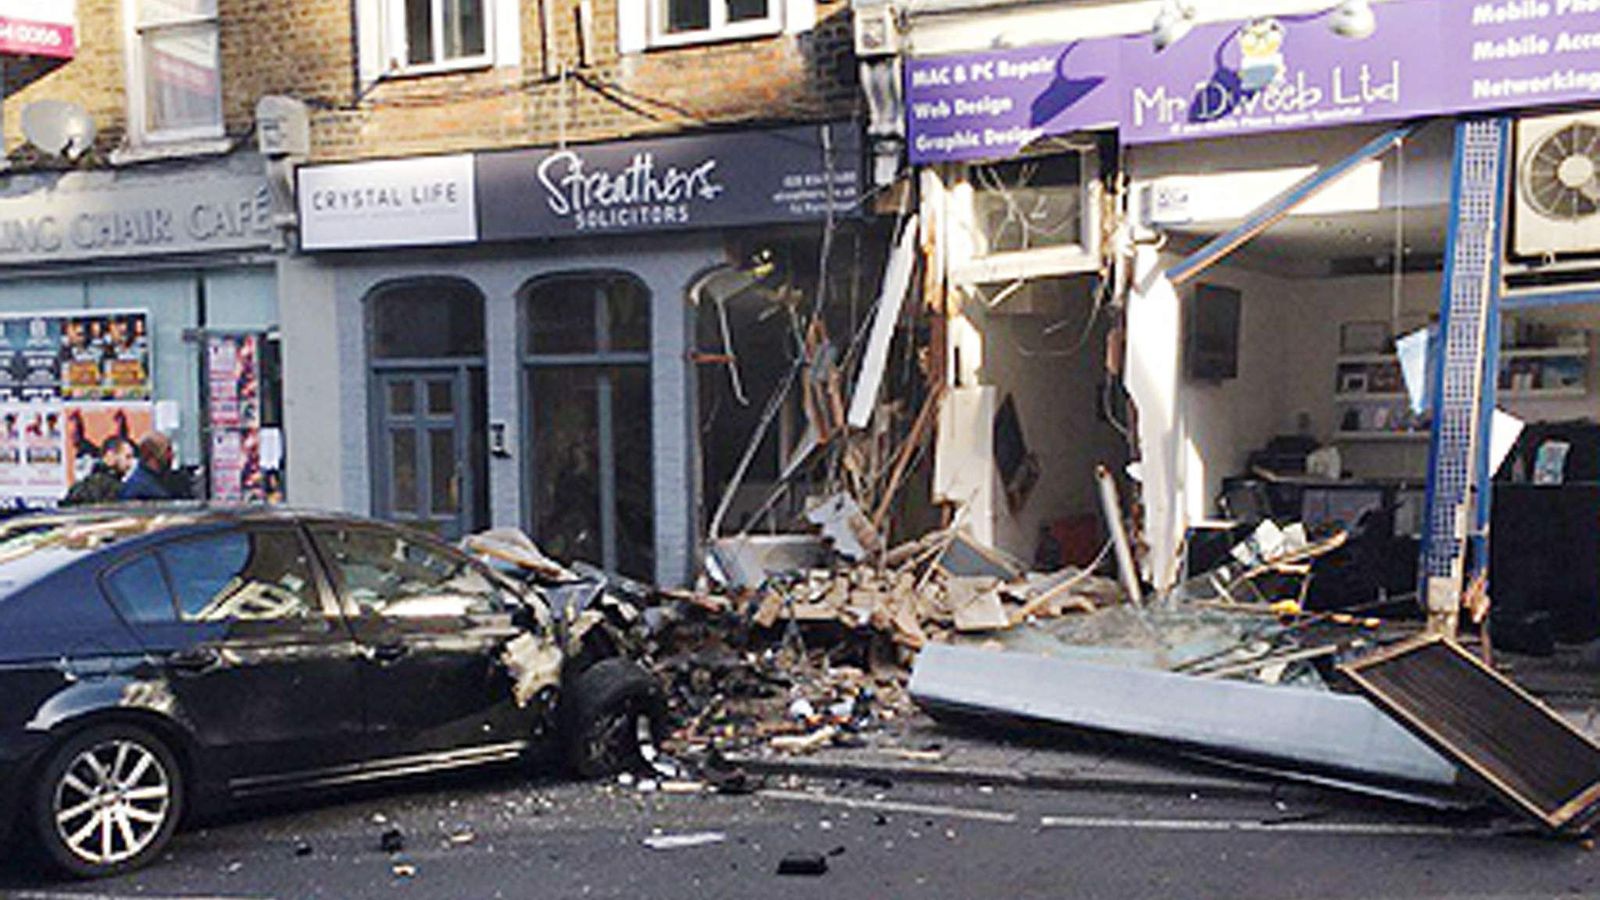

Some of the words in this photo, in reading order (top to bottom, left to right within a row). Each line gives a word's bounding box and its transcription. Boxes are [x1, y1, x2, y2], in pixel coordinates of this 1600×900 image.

[1473, 1, 1550, 24] Mobile
[1473, 35, 1550, 60] Mobile
[912, 68, 951, 87] MAC
[970, 61, 994, 81] PC
[997, 58, 1055, 79] Repair
[1473, 69, 1600, 98] Networking
[912, 99, 951, 118] Web
[954, 96, 1012, 115] Design
[1133, 86, 1187, 126] Mr
[1332, 60, 1399, 106] Ltd
[916, 132, 979, 152] Graphic
[312, 188, 403, 211] CRYSTAL
[411, 182, 457, 204] LIFE
[537, 150, 723, 215] Streathers
[71, 208, 173, 248] CHAIR
[187, 186, 271, 241] CAFÉ
[575, 205, 689, 230] SOLICITORS
